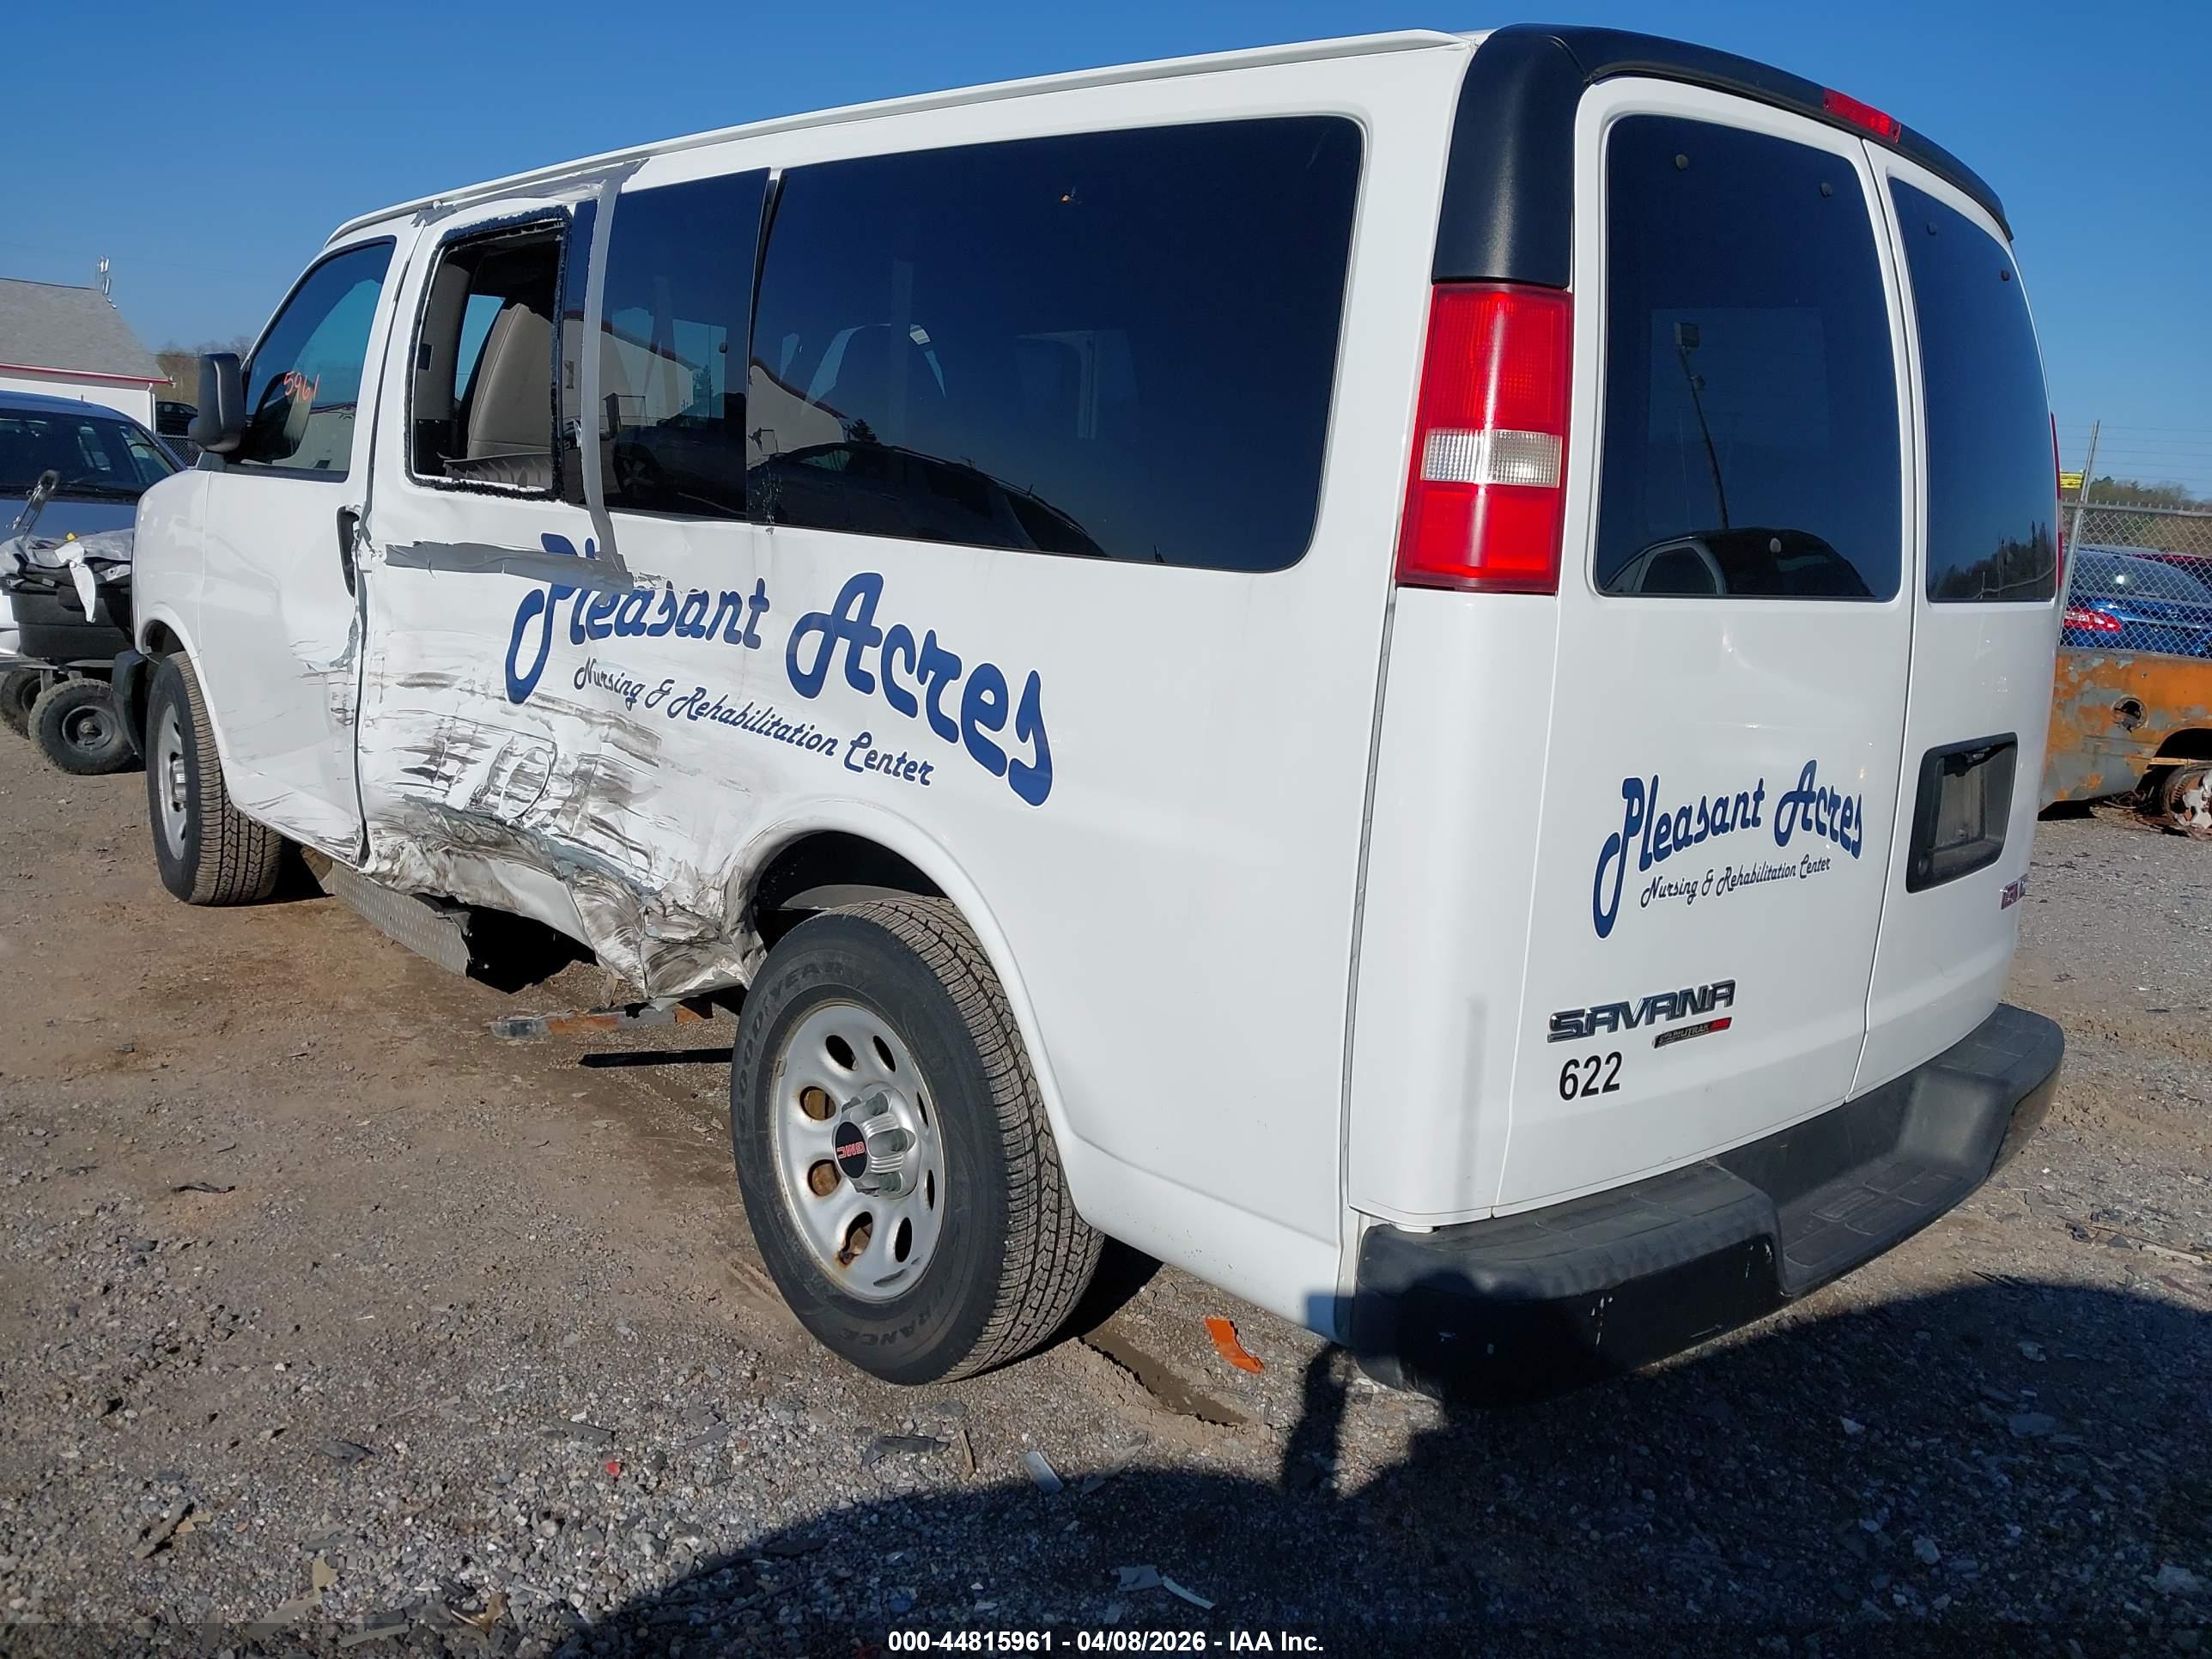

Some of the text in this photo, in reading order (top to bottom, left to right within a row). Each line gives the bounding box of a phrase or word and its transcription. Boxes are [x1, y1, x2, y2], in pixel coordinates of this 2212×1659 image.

[283, 370, 320, 404] 5961
[505, 532, 1053, 806] Pleasant Acres
[574, 657, 934, 786] Nursing & Rehabilitation Center
[1593, 759, 1863, 939] Pleasant Acres
[1640, 854, 1831, 908] Nursing & Rehabilitation Center
[1547, 979, 1735, 1043] SAVANA
[1559, 1051, 1623, 1101] 622
[836, 1140, 866, 1159] GMC
